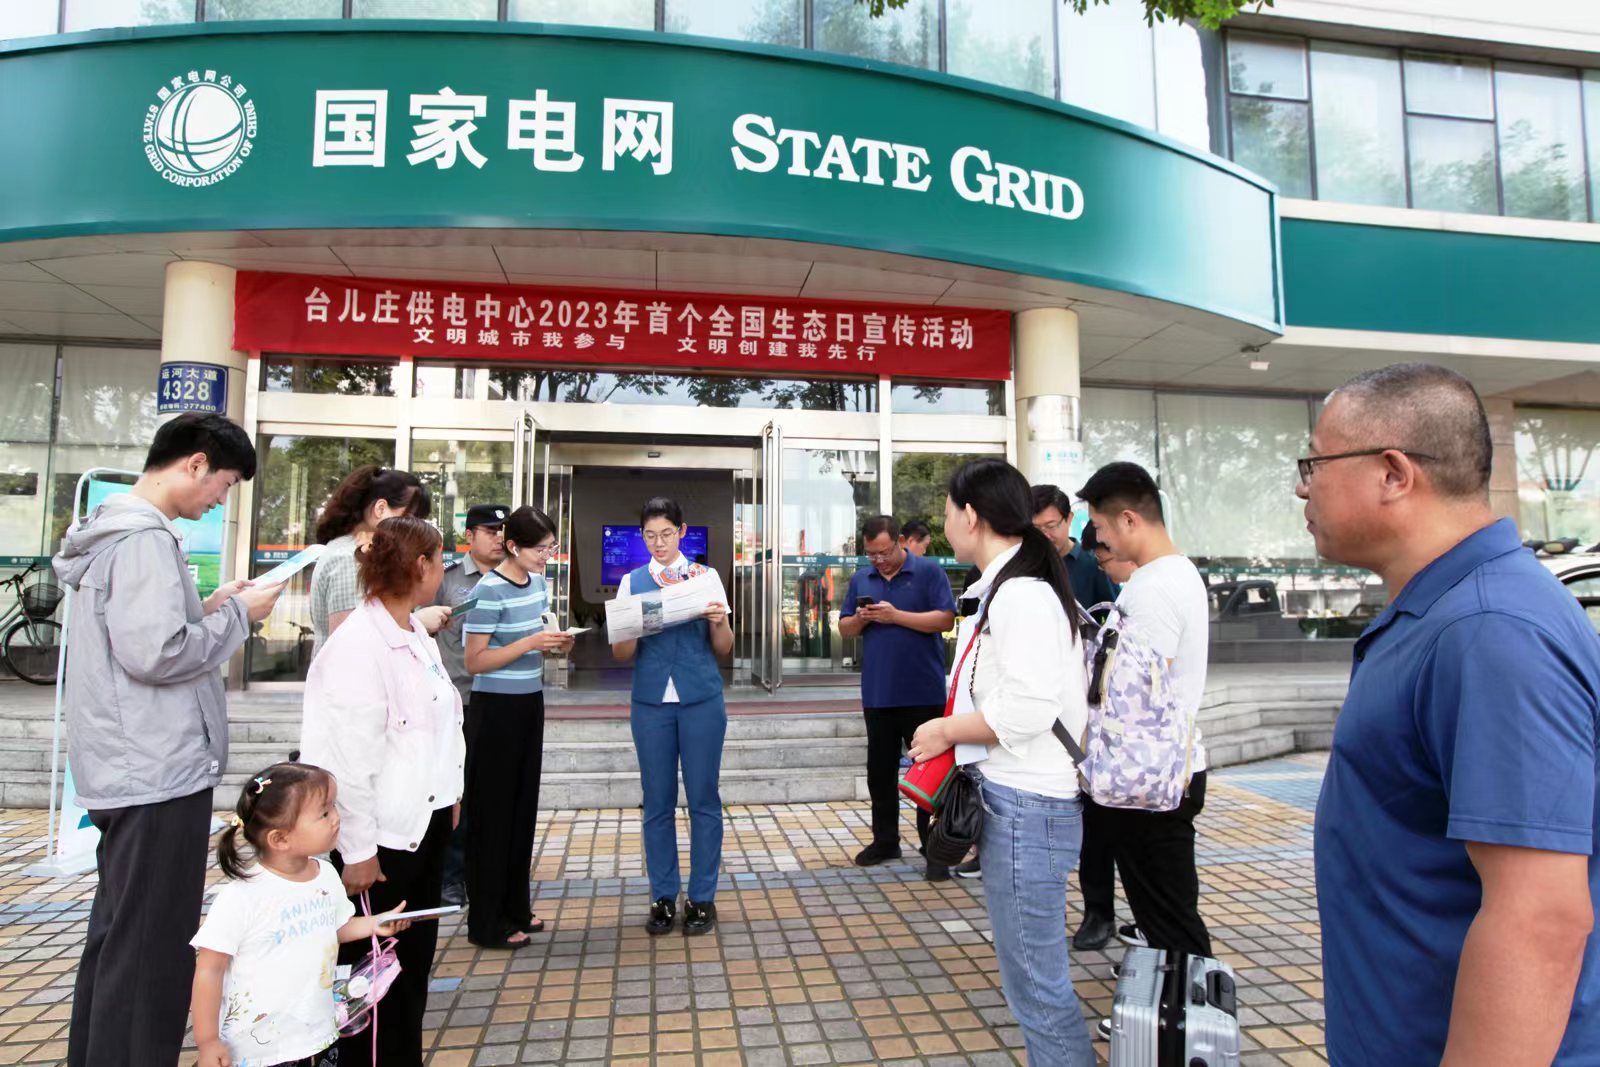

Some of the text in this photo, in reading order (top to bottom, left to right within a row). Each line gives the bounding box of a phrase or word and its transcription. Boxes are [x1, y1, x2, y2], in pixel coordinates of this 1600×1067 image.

[144, 99, 257, 187] STATE GRID CORPORATION OF CHINA
[312, 86, 674, 175] 国家电网
[731, 113, 1085, 220] STATE GRID
[305, 287, 974, 349] 台儿庄供电中心2023年首个全国生态日宣传活动
[413, 326, 876, 361] 文明城市我参与 文明创建我先行
[163, 380, 210, 401] 4328
[273, 911, 337, 944] PARADIS
[281, 896, 332, 922] ANIMAL
